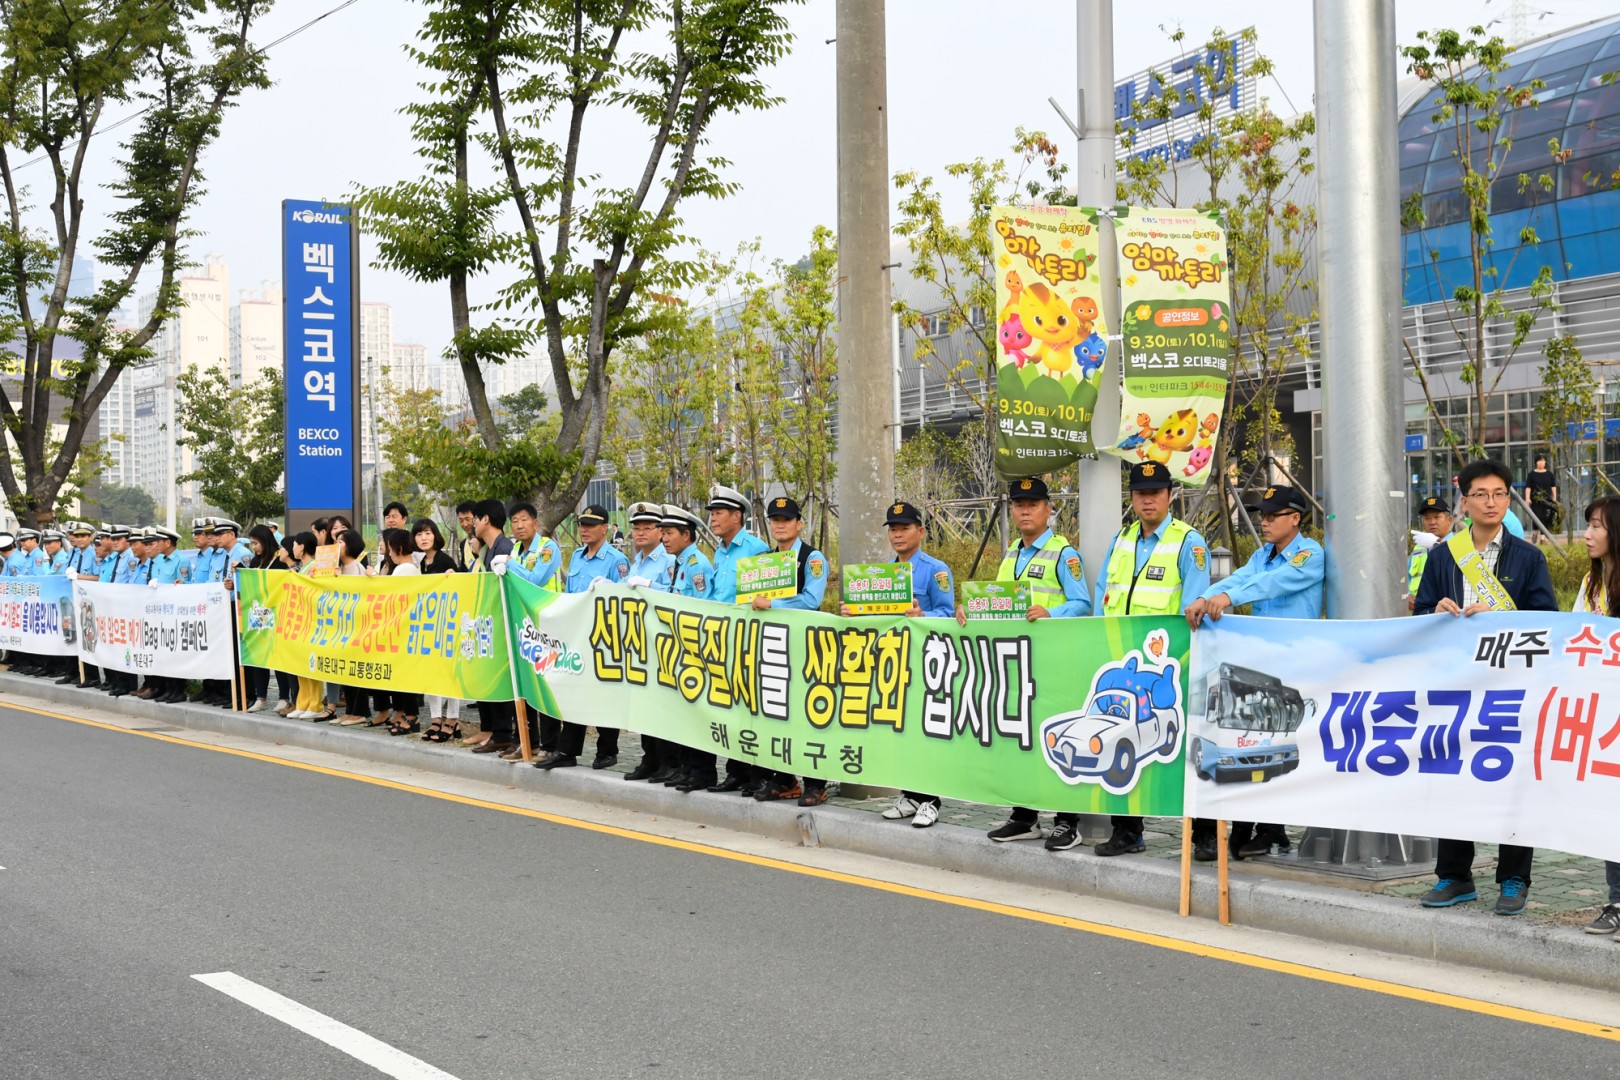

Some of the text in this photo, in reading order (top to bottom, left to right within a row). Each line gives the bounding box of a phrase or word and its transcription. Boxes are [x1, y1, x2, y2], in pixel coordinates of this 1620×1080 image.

[293, 209, 343, 225] KORAIL
[1122, 241, 1222, 289] 엄마 까투리
[1162, 311, 1199, 323] 공연정보
[303, 242, 336, 412] 벡스코역
[1131, 352, 1227, 371] 벡스코 오디토리움
[1149, 382, 1189, 393] 인터파크
[298, 428, 340, 440] BEXCO
[999, 418, 1047, 438] 벡스코
[298, 444, 343, 457] Station
[1016, 448, 1057, 459] 인터파크
[849, 578, 869, 592] 승용차
[867, 604, 899, 612] 해운대구
[968, 596, 989, 611] 승용차
[991, 596, 1013, 611] 요일제
[276, 583, 316, 642] 교통질서
[350, 593, 409, 654] 교통안전
[108, 617, 127, 645] 앞으로
[161, 618, 178, 651] hug)
[180, 620, 208, 651] 캠페인
[1475, 629, 1550, 668] 매주
[317, 657, 392, 681] 해운대구 교통행정과
[589, 596, 648, 685] 선진
[654, 605, 790, 721] 교통질서를
[803, 625, 912, 733] 생활화
[922, 631, 1036, 752] 합시다
[1319, 688, 1526, 782] 대중교통
[710, 721, 864, 775] 해운대구청
